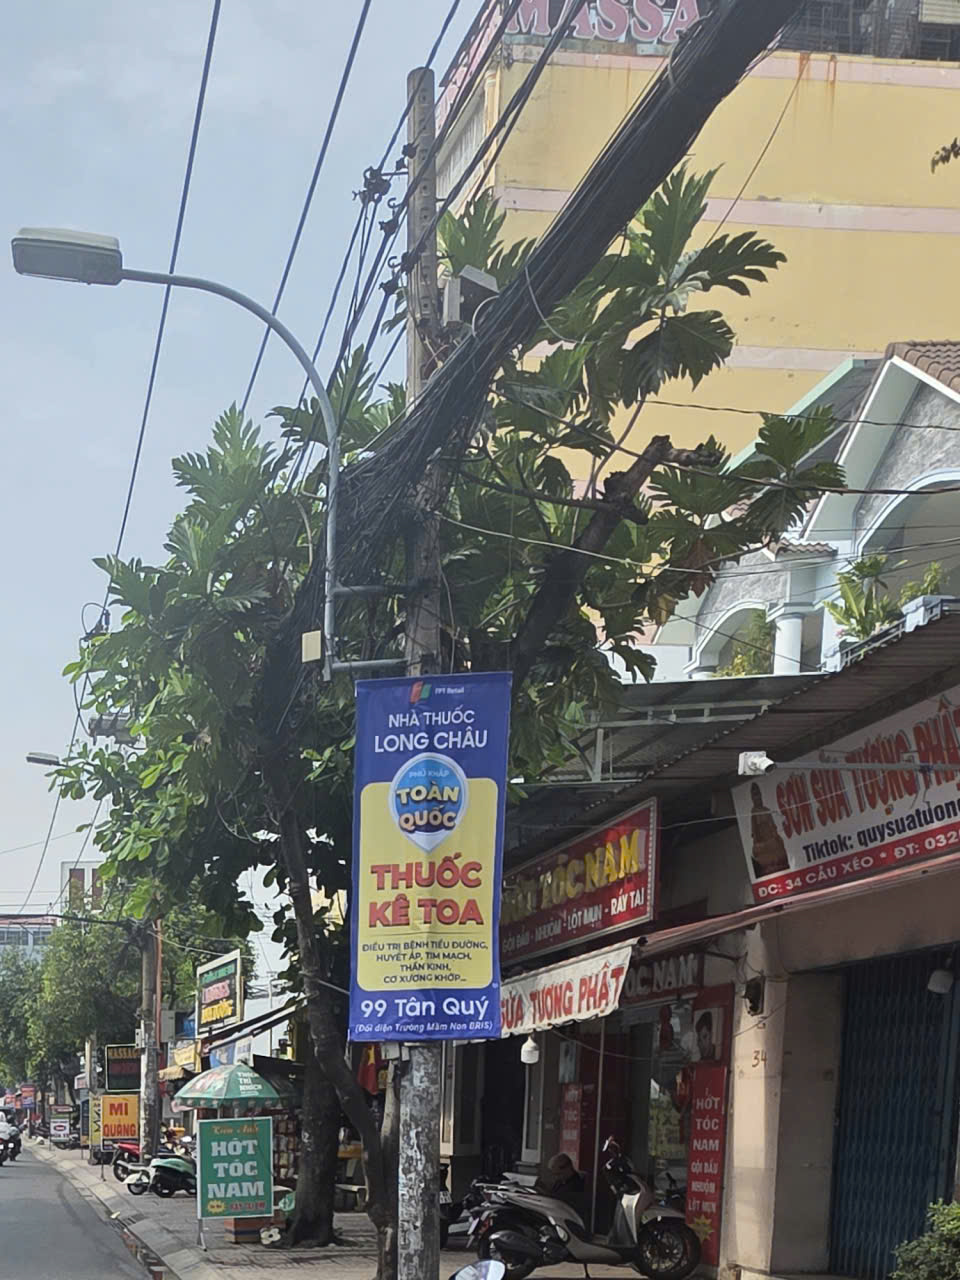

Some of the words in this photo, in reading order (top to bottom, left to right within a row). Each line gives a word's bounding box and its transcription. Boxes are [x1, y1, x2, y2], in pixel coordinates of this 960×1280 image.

[388, 709, 420, 728] NHÀ
[423, 705, 475, 725] THUỐC
[375, 732, 429, 753] LONG
[433, 726, 487, 749] CHÂU
[913, 695, 960, 791] PHẬ
[396, 781, 460, 805] TOÀN
[399, 804, 457, 831] QUỐC
[803, 834, 854, 863] Tiktok:
[857, 798, 960, 848] quysuatuon
[370, 852, 483, 890] THUỐC
[584, 829, 646, 893] NAM
[785, 879, 802, 891] 34
[842, 856, 874, 874] XÉO
[894, 842, 920, 859] ĐT:
[925, 829, 960, 850] 032
[369, 893, 410, 928] KÊ
[417, 898, 484, 925] TOA
[610, 888, 630, 916] RÁY
[630, 888, 645, 908] TAI
[425, 952, 440, 960] TIM
[427, 964, 451, 972] KINH,
[399, 974, 433, 983] XƯƠNG
[361, 1000, 387, 1018] 99
[394, 997, 435, 1017] Tân
[442, 996, 489, 1020] Quý
[450, 1021, 467, 1030] Non
[752, 1050, 767, 1067] 34
[696, 1115, 720, 1130] TÓC
[693, 1139, 720, 1151] NAM
[213, 1159, 258, 1178] TÓC
[208, 1181, 264, 1198] NAM
